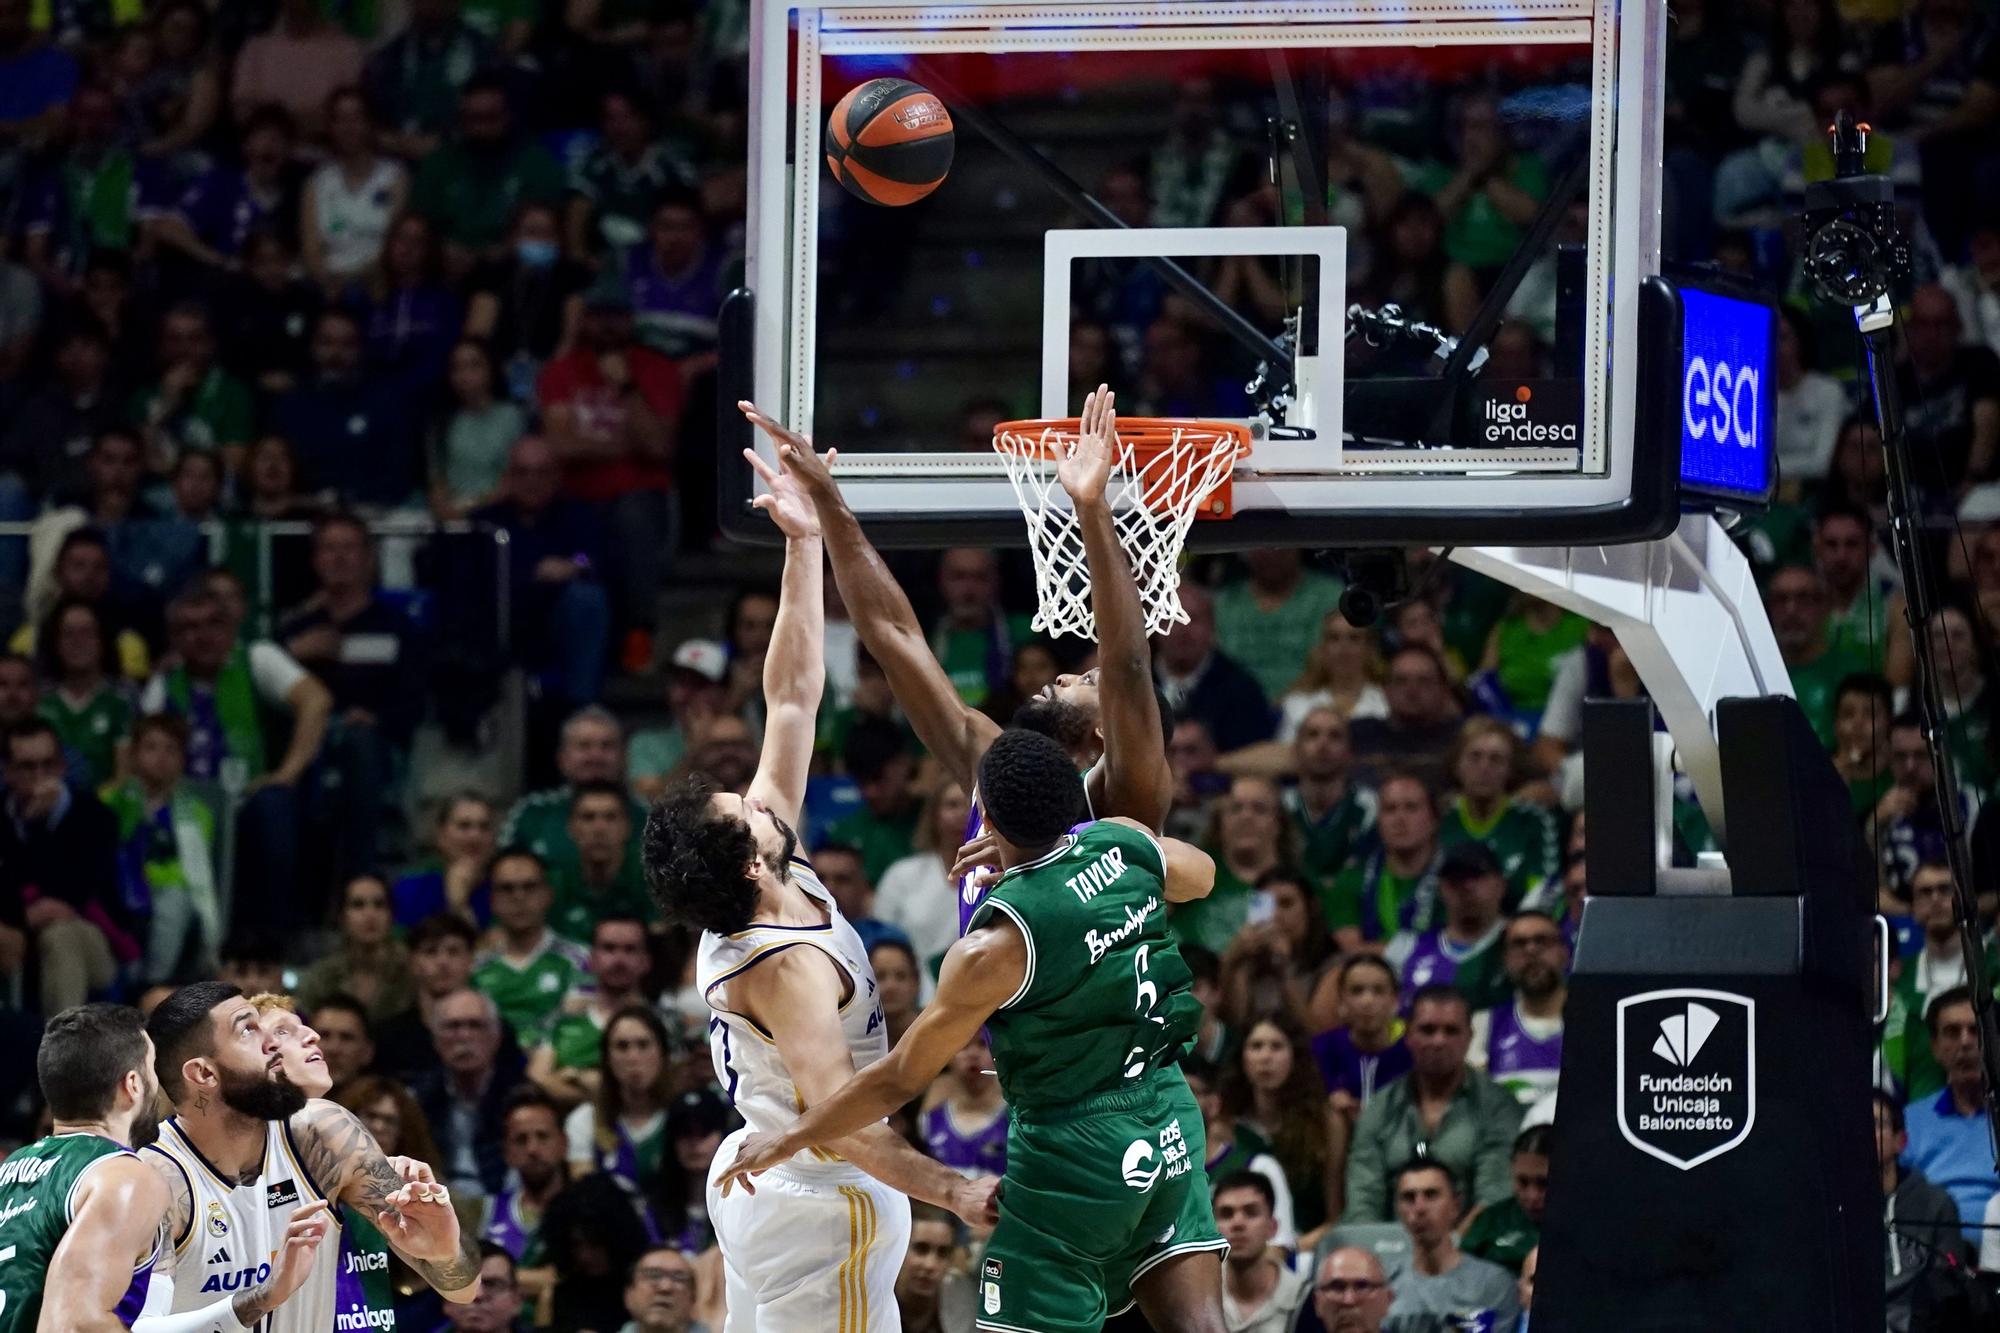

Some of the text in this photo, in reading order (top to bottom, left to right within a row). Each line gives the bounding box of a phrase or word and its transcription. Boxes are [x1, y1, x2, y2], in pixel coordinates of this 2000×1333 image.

[1485, 398, 1527, 423] liga
[1684, 356, 1759, 449] esa
[1485, 420, 1577, 442] endesa
[1064, 846, 1128, 904] TAYLOR
[1639, 1072, 1733, 1093] Fundación
[1653, 1095, 1720, 1118] Unicaja
[1639, 1115, 1734, 1131] Baloncesto
[985, 1265, 999, 1276] acb
